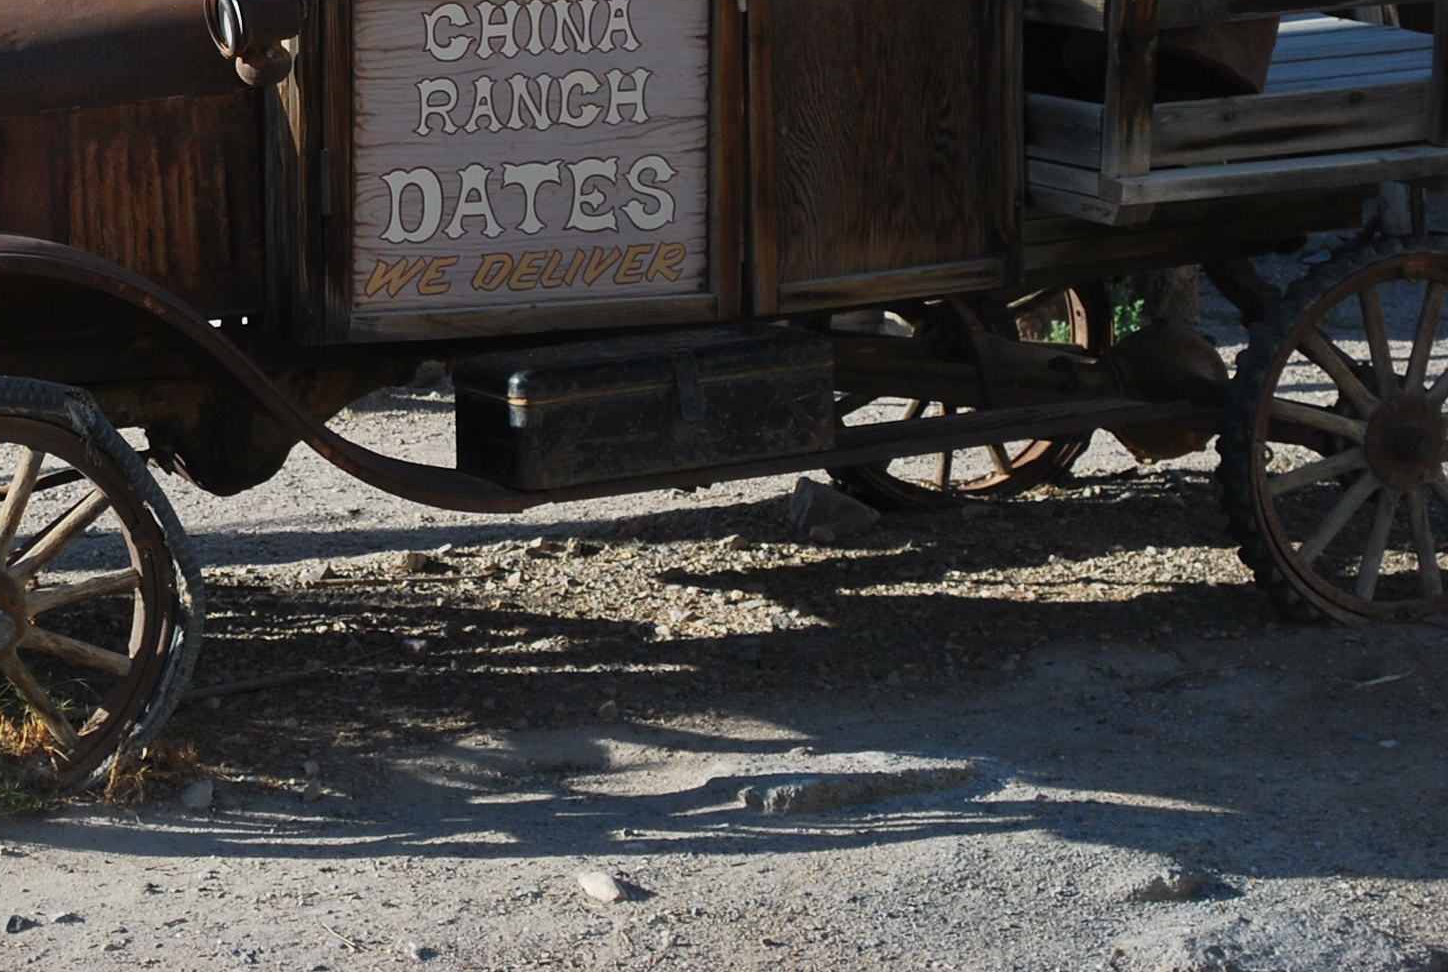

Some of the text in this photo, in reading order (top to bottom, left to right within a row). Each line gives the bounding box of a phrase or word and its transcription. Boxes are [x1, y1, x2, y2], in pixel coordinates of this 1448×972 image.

[413, 66, 652, 137] RANCH
[379, 153, 679, 244] DATES
[364, 242, 688, 298] WE DELIVER
